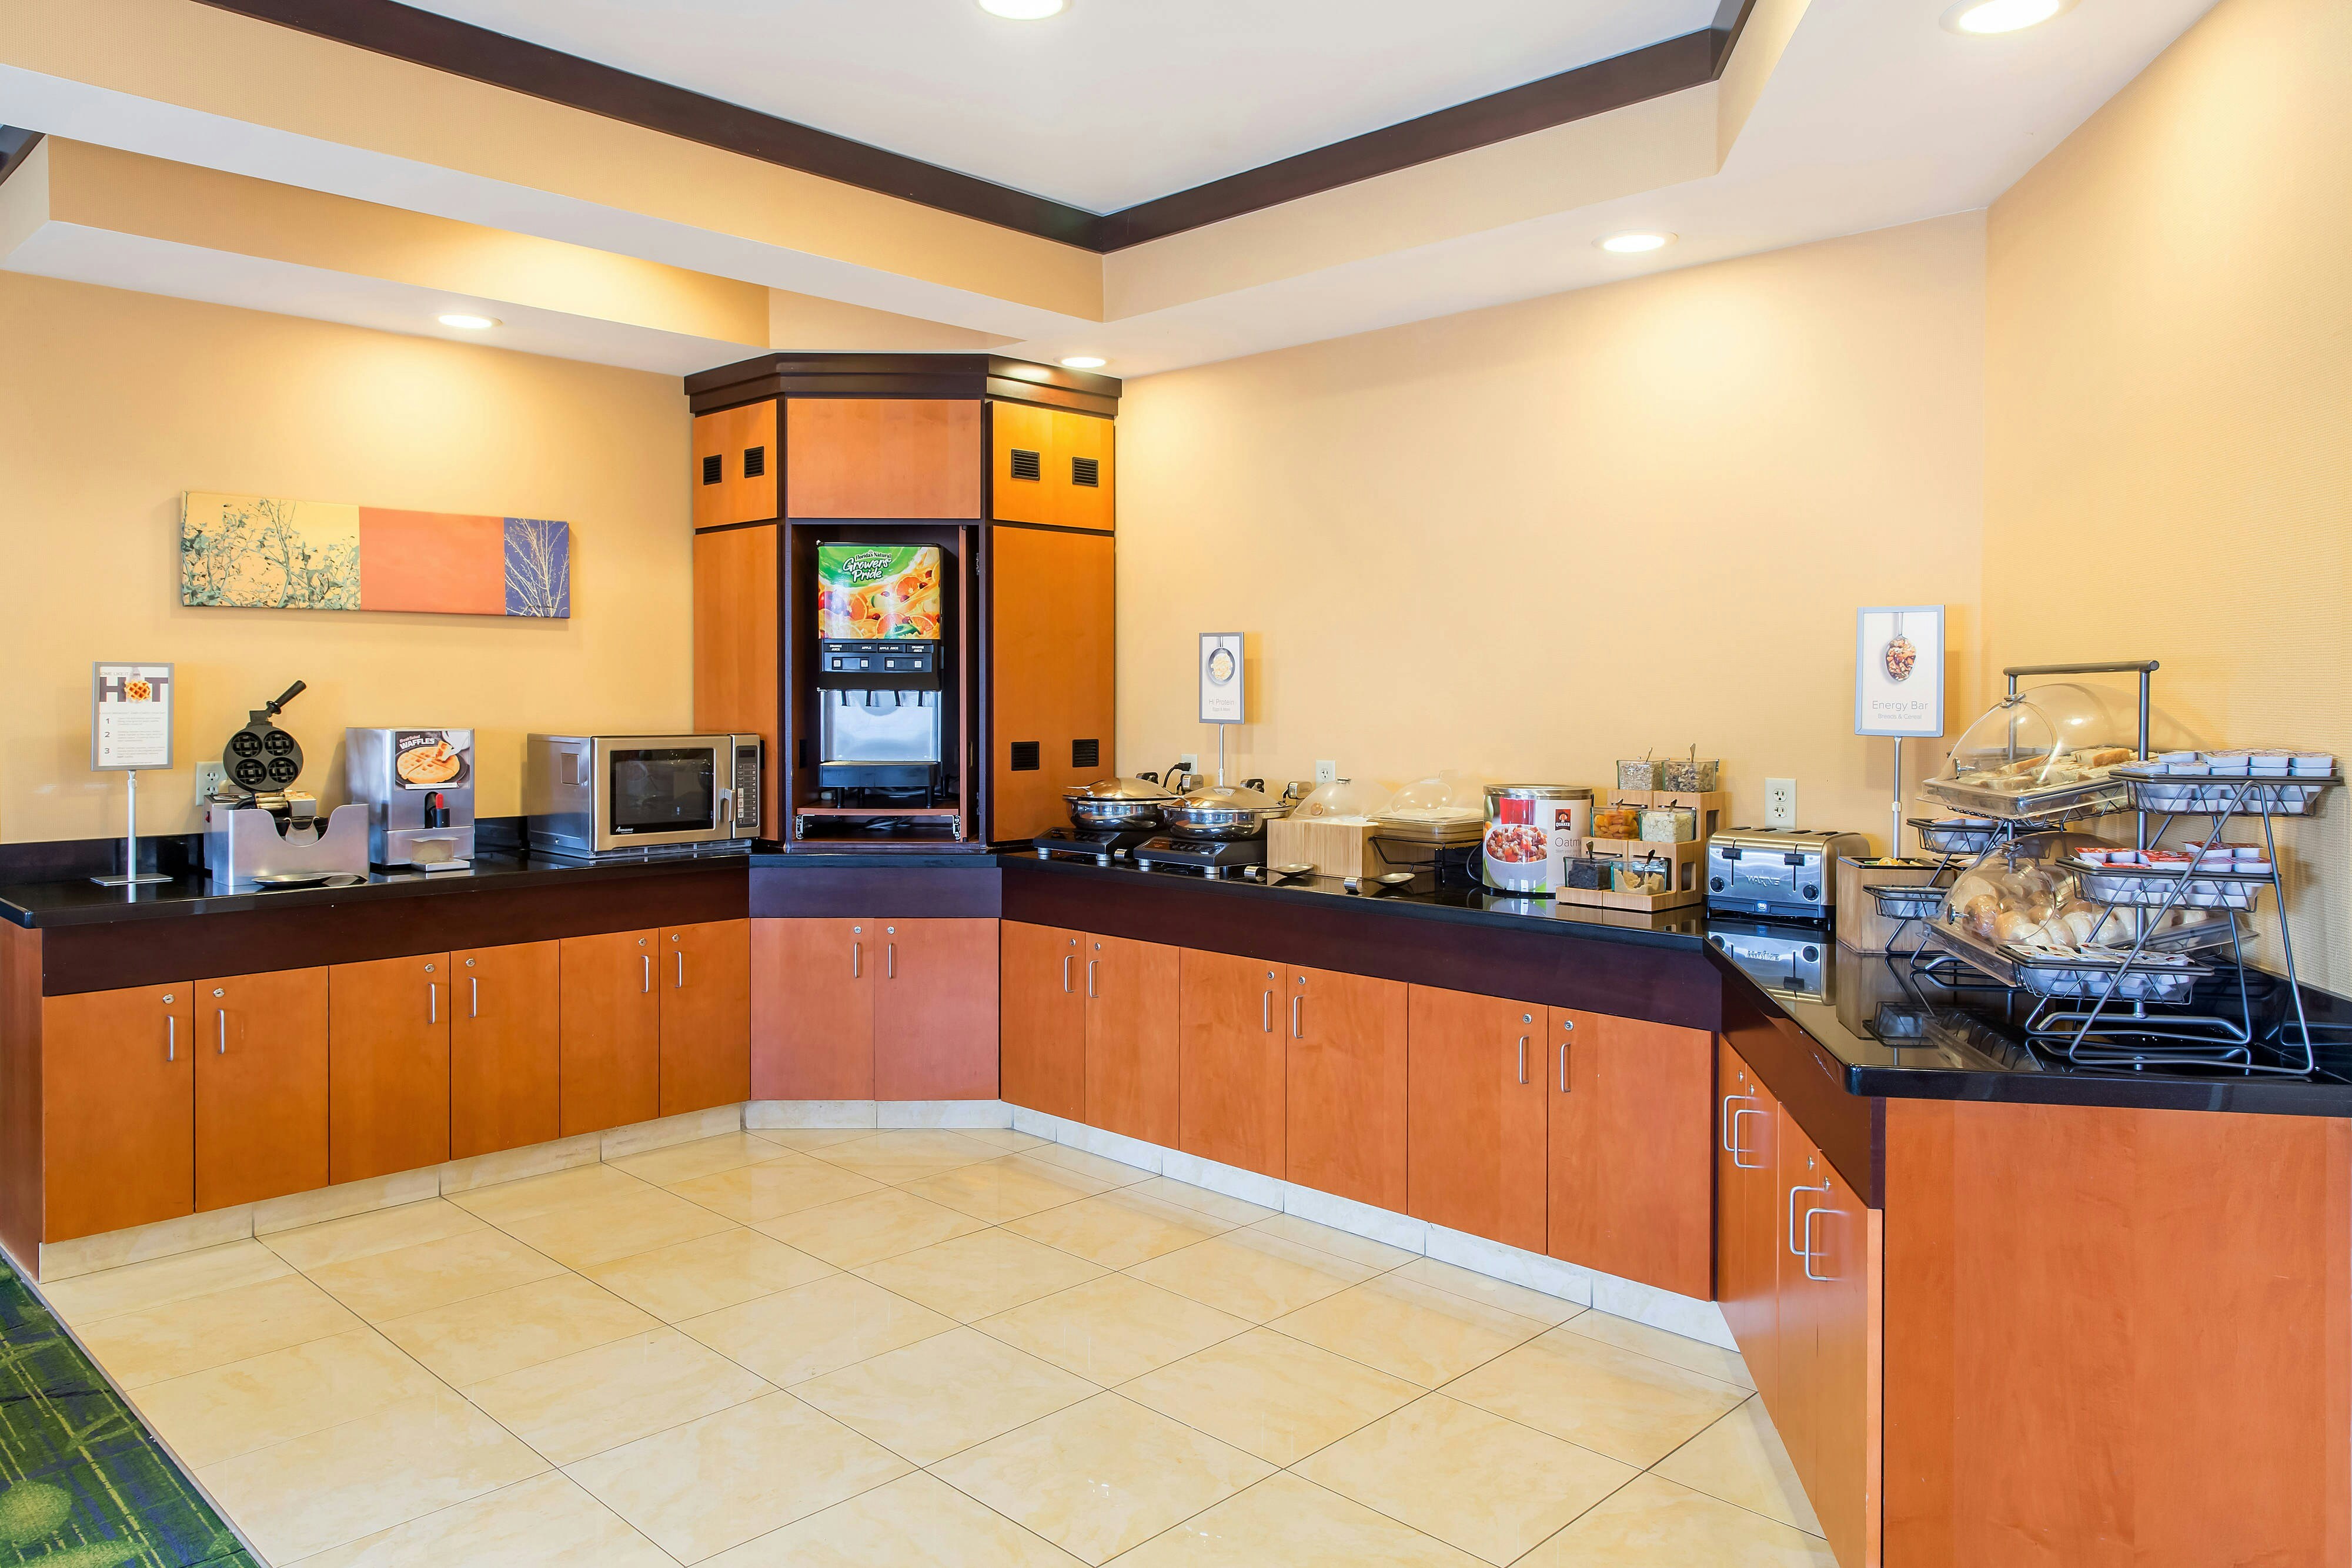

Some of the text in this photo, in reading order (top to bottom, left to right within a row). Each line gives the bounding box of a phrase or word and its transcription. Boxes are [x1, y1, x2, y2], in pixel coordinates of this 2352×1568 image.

[851, 567, 883, 582] Pride
[1872, 700, 1929, 711] Energy Bar
[399, 738, 435, 750] WAFFLES
[1555, 837, 1582, 847] Oatm
